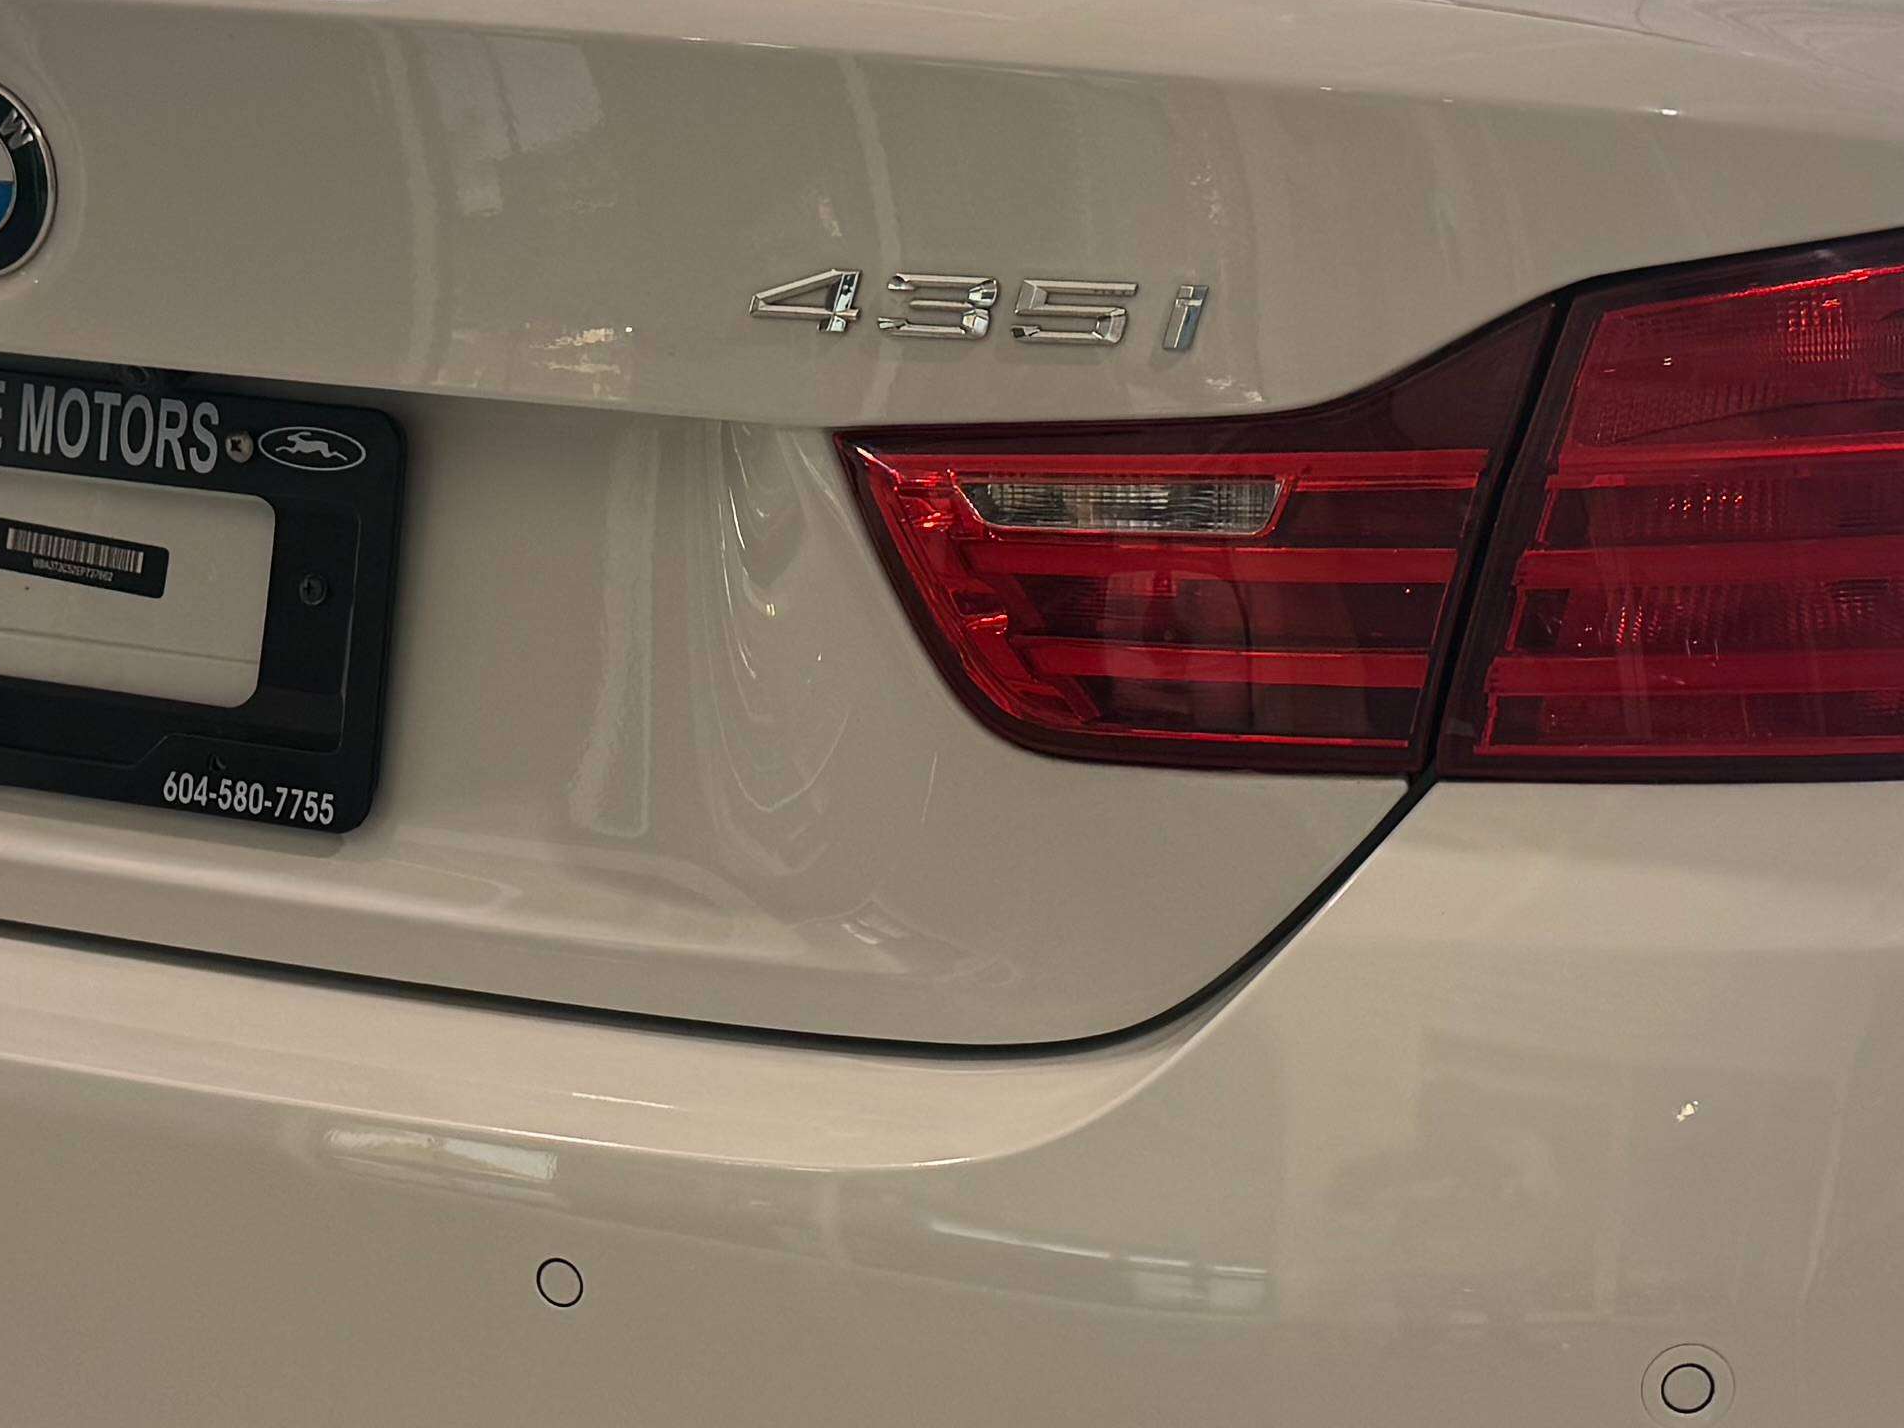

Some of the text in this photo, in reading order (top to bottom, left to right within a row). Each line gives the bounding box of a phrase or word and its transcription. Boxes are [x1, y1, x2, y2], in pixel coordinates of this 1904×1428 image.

[749, 268, 1210, 350] 435i
[17, 382, 220, 474] MOTORS
[162, 770, 335, 826] 604-580-7755
